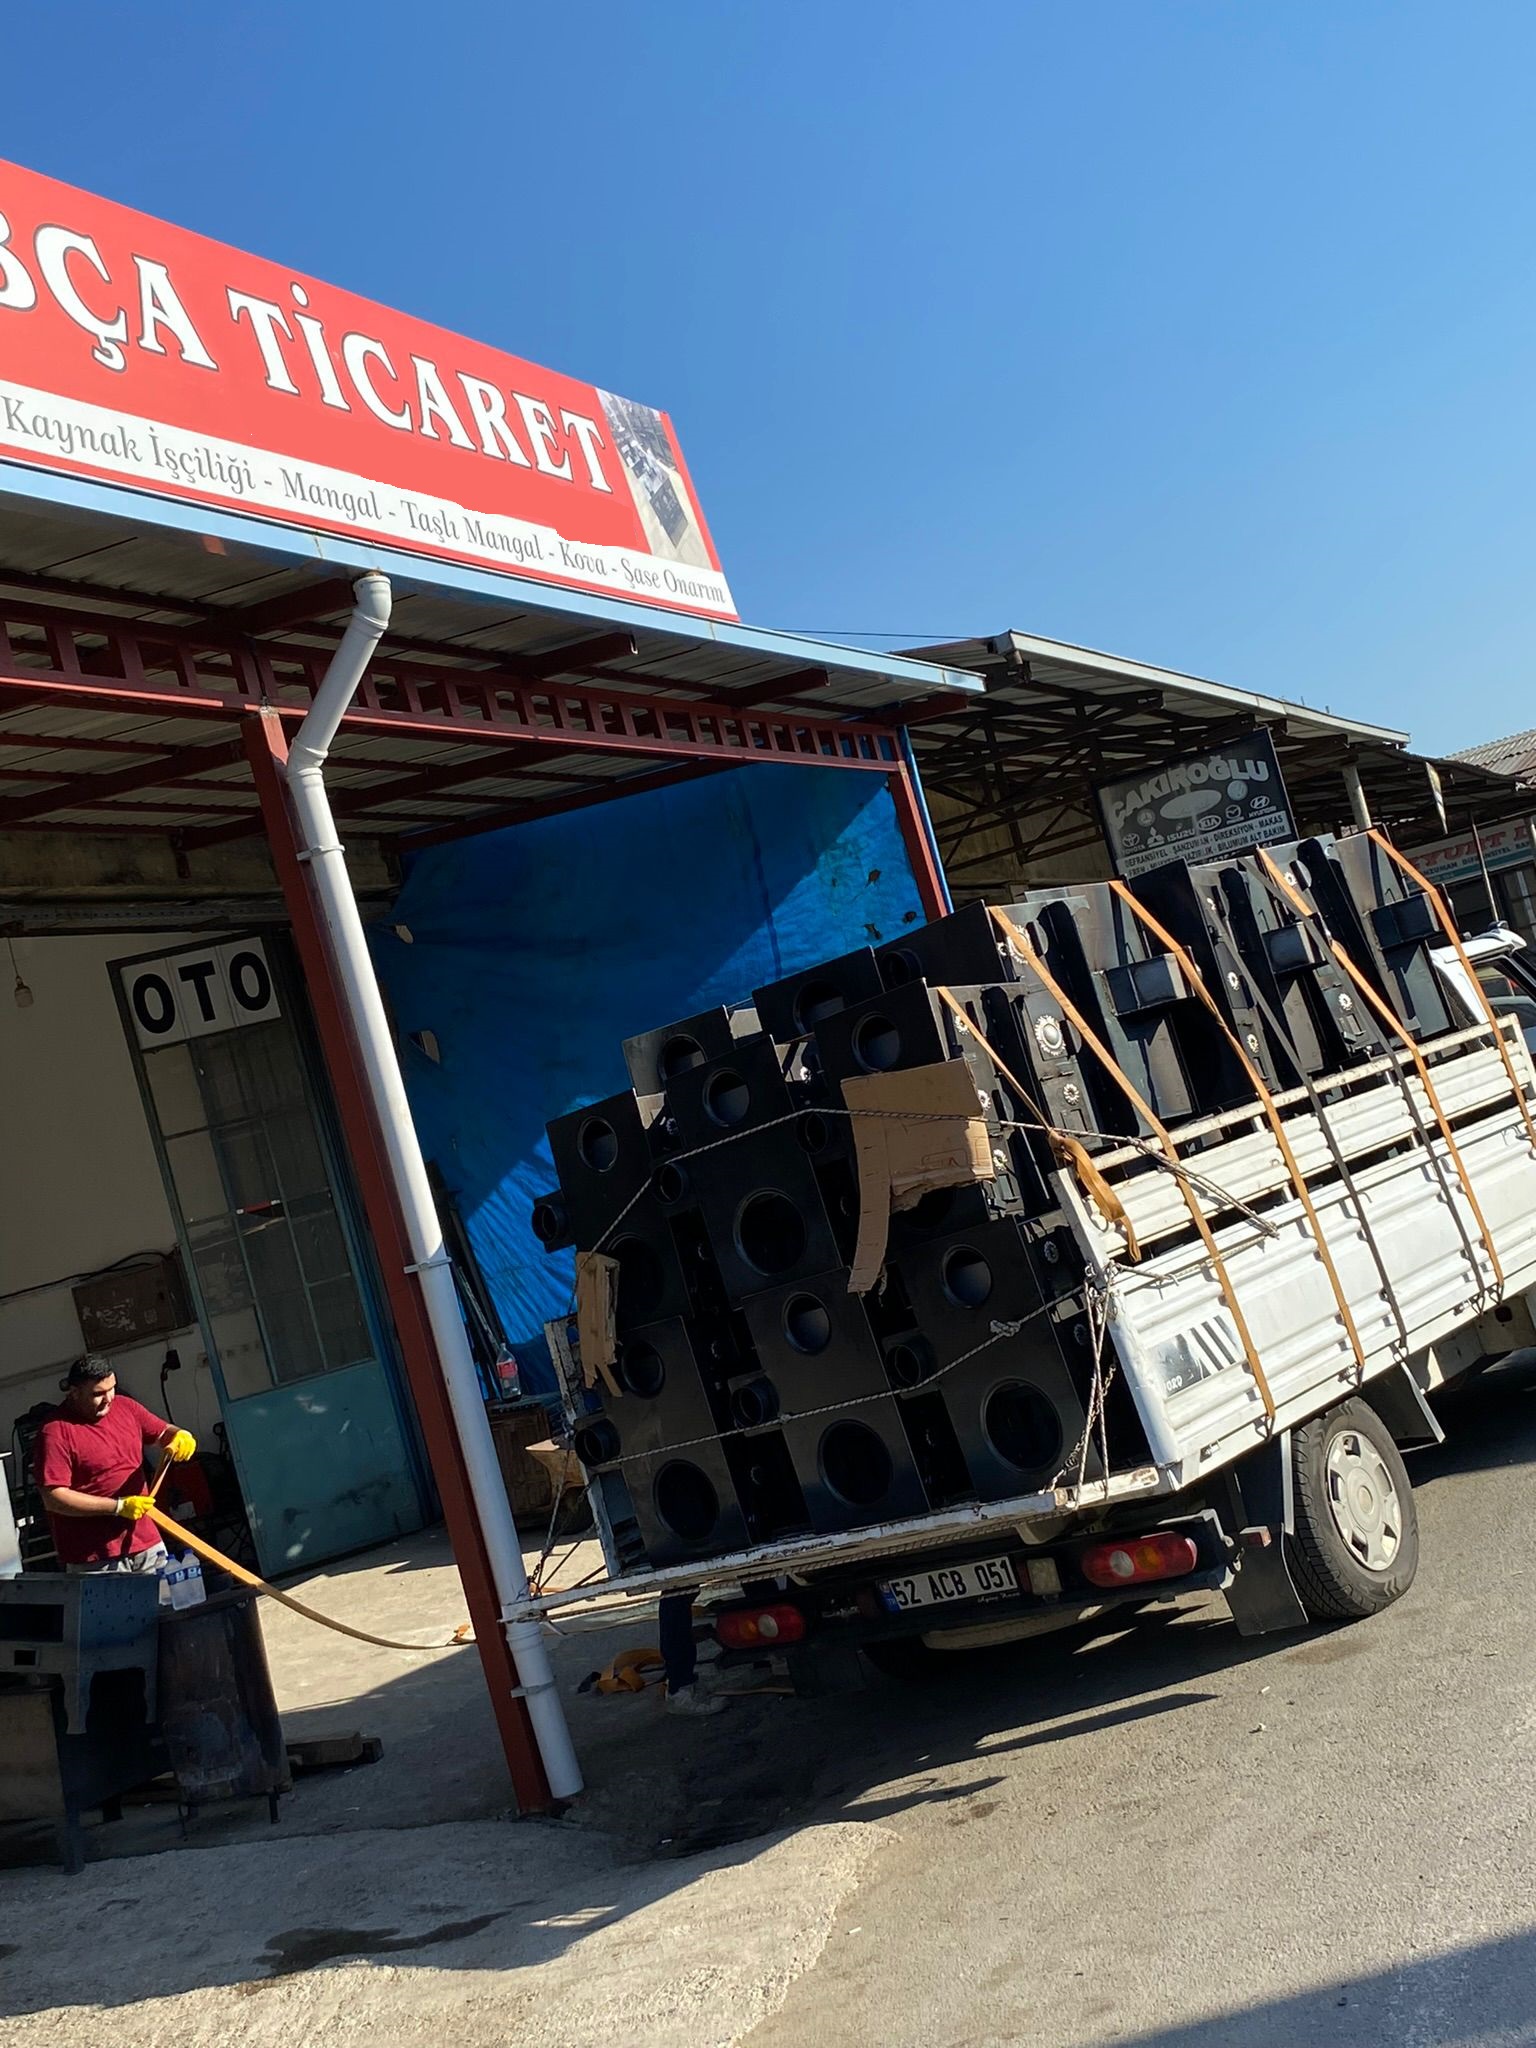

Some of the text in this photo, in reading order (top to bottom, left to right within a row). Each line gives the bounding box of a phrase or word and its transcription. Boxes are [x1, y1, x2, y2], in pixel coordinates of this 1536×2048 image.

[225, 281, 614, 494] TİCARET
[2, 396, 143, 462] Kaynak
[149, 426, 256, 495] İşçiliği
[279, 467, 383, 521] Mangal
[400, 499, 460, 543] Taşlı
[462, 516, 544, 562] Mangal
[558, 541, 607, 576] Kova
[620, 557, 661, 589] Şase
[663, 569, 726, 603] Onarım
[1250, 829, 1263, 843] ALT
[1259, 814, 1284, 830] MAKAS
[133, 952, 271, 1034] OTO
[891, 1579, 923, 1606] 52
[928, 1569, 967, 1601] ACB
[974, 1559, 1014, 1592] 051
